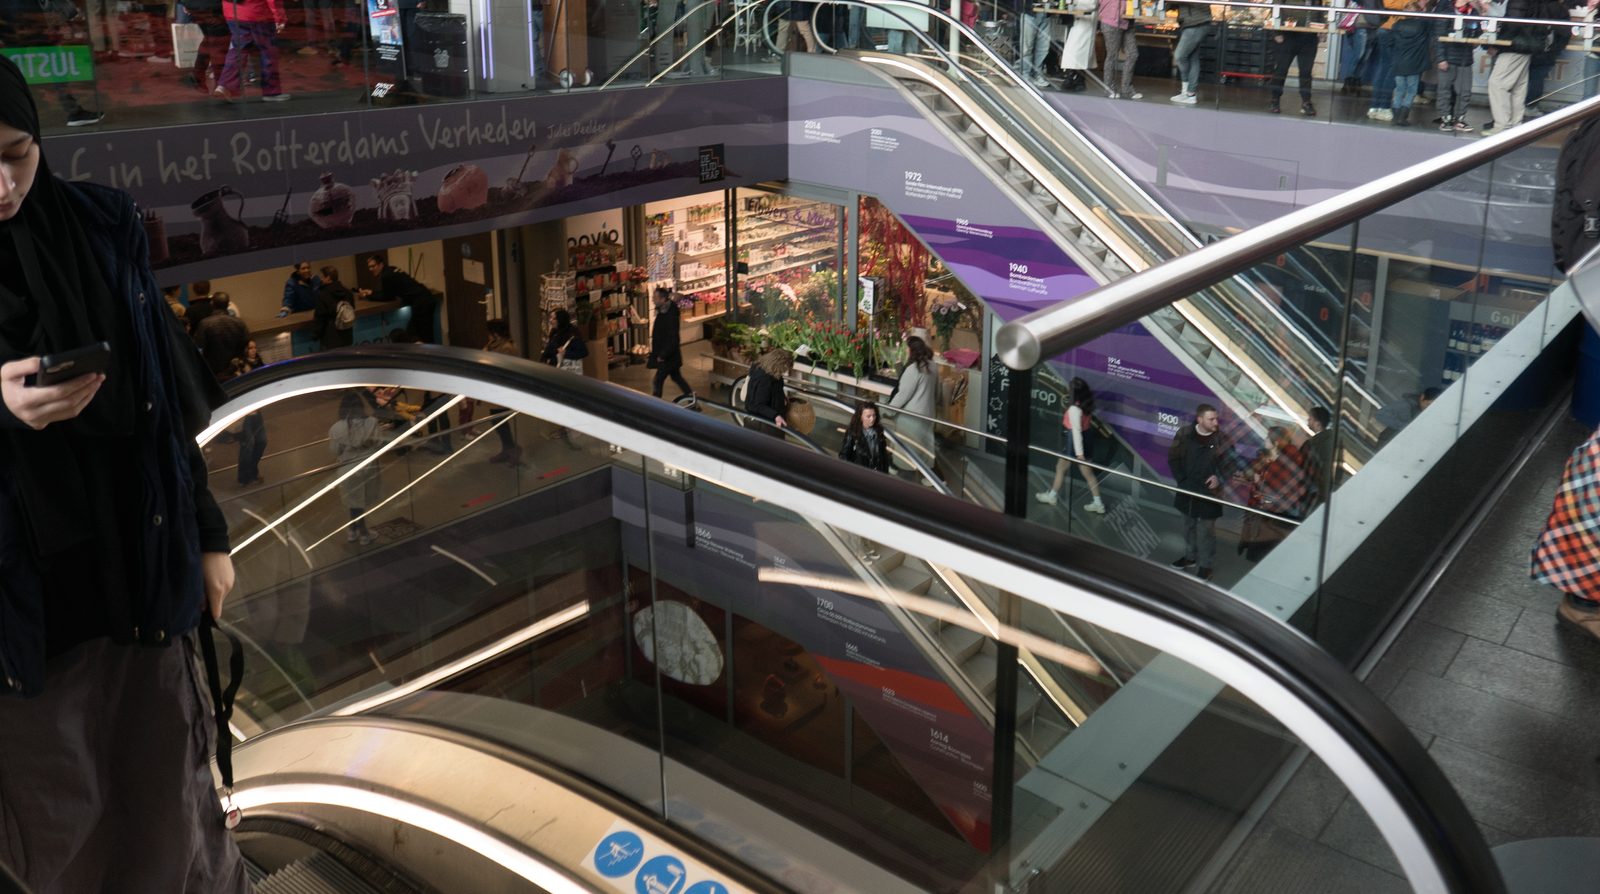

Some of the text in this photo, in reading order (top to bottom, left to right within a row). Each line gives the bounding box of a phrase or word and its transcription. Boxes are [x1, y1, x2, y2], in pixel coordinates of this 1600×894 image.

[106, 142, 144, 189] in
[156, 138, 218, 185] het
[230, 120, 409, 175] Rotterdams
[418, 105, 537, 150] Verheden
[905, 170, 922, 181] 1972
[1008, 262, 1028, 274] 1940
[1157, 412, 1179, 425] 1900
[929, 727, 949, 744] 1614
